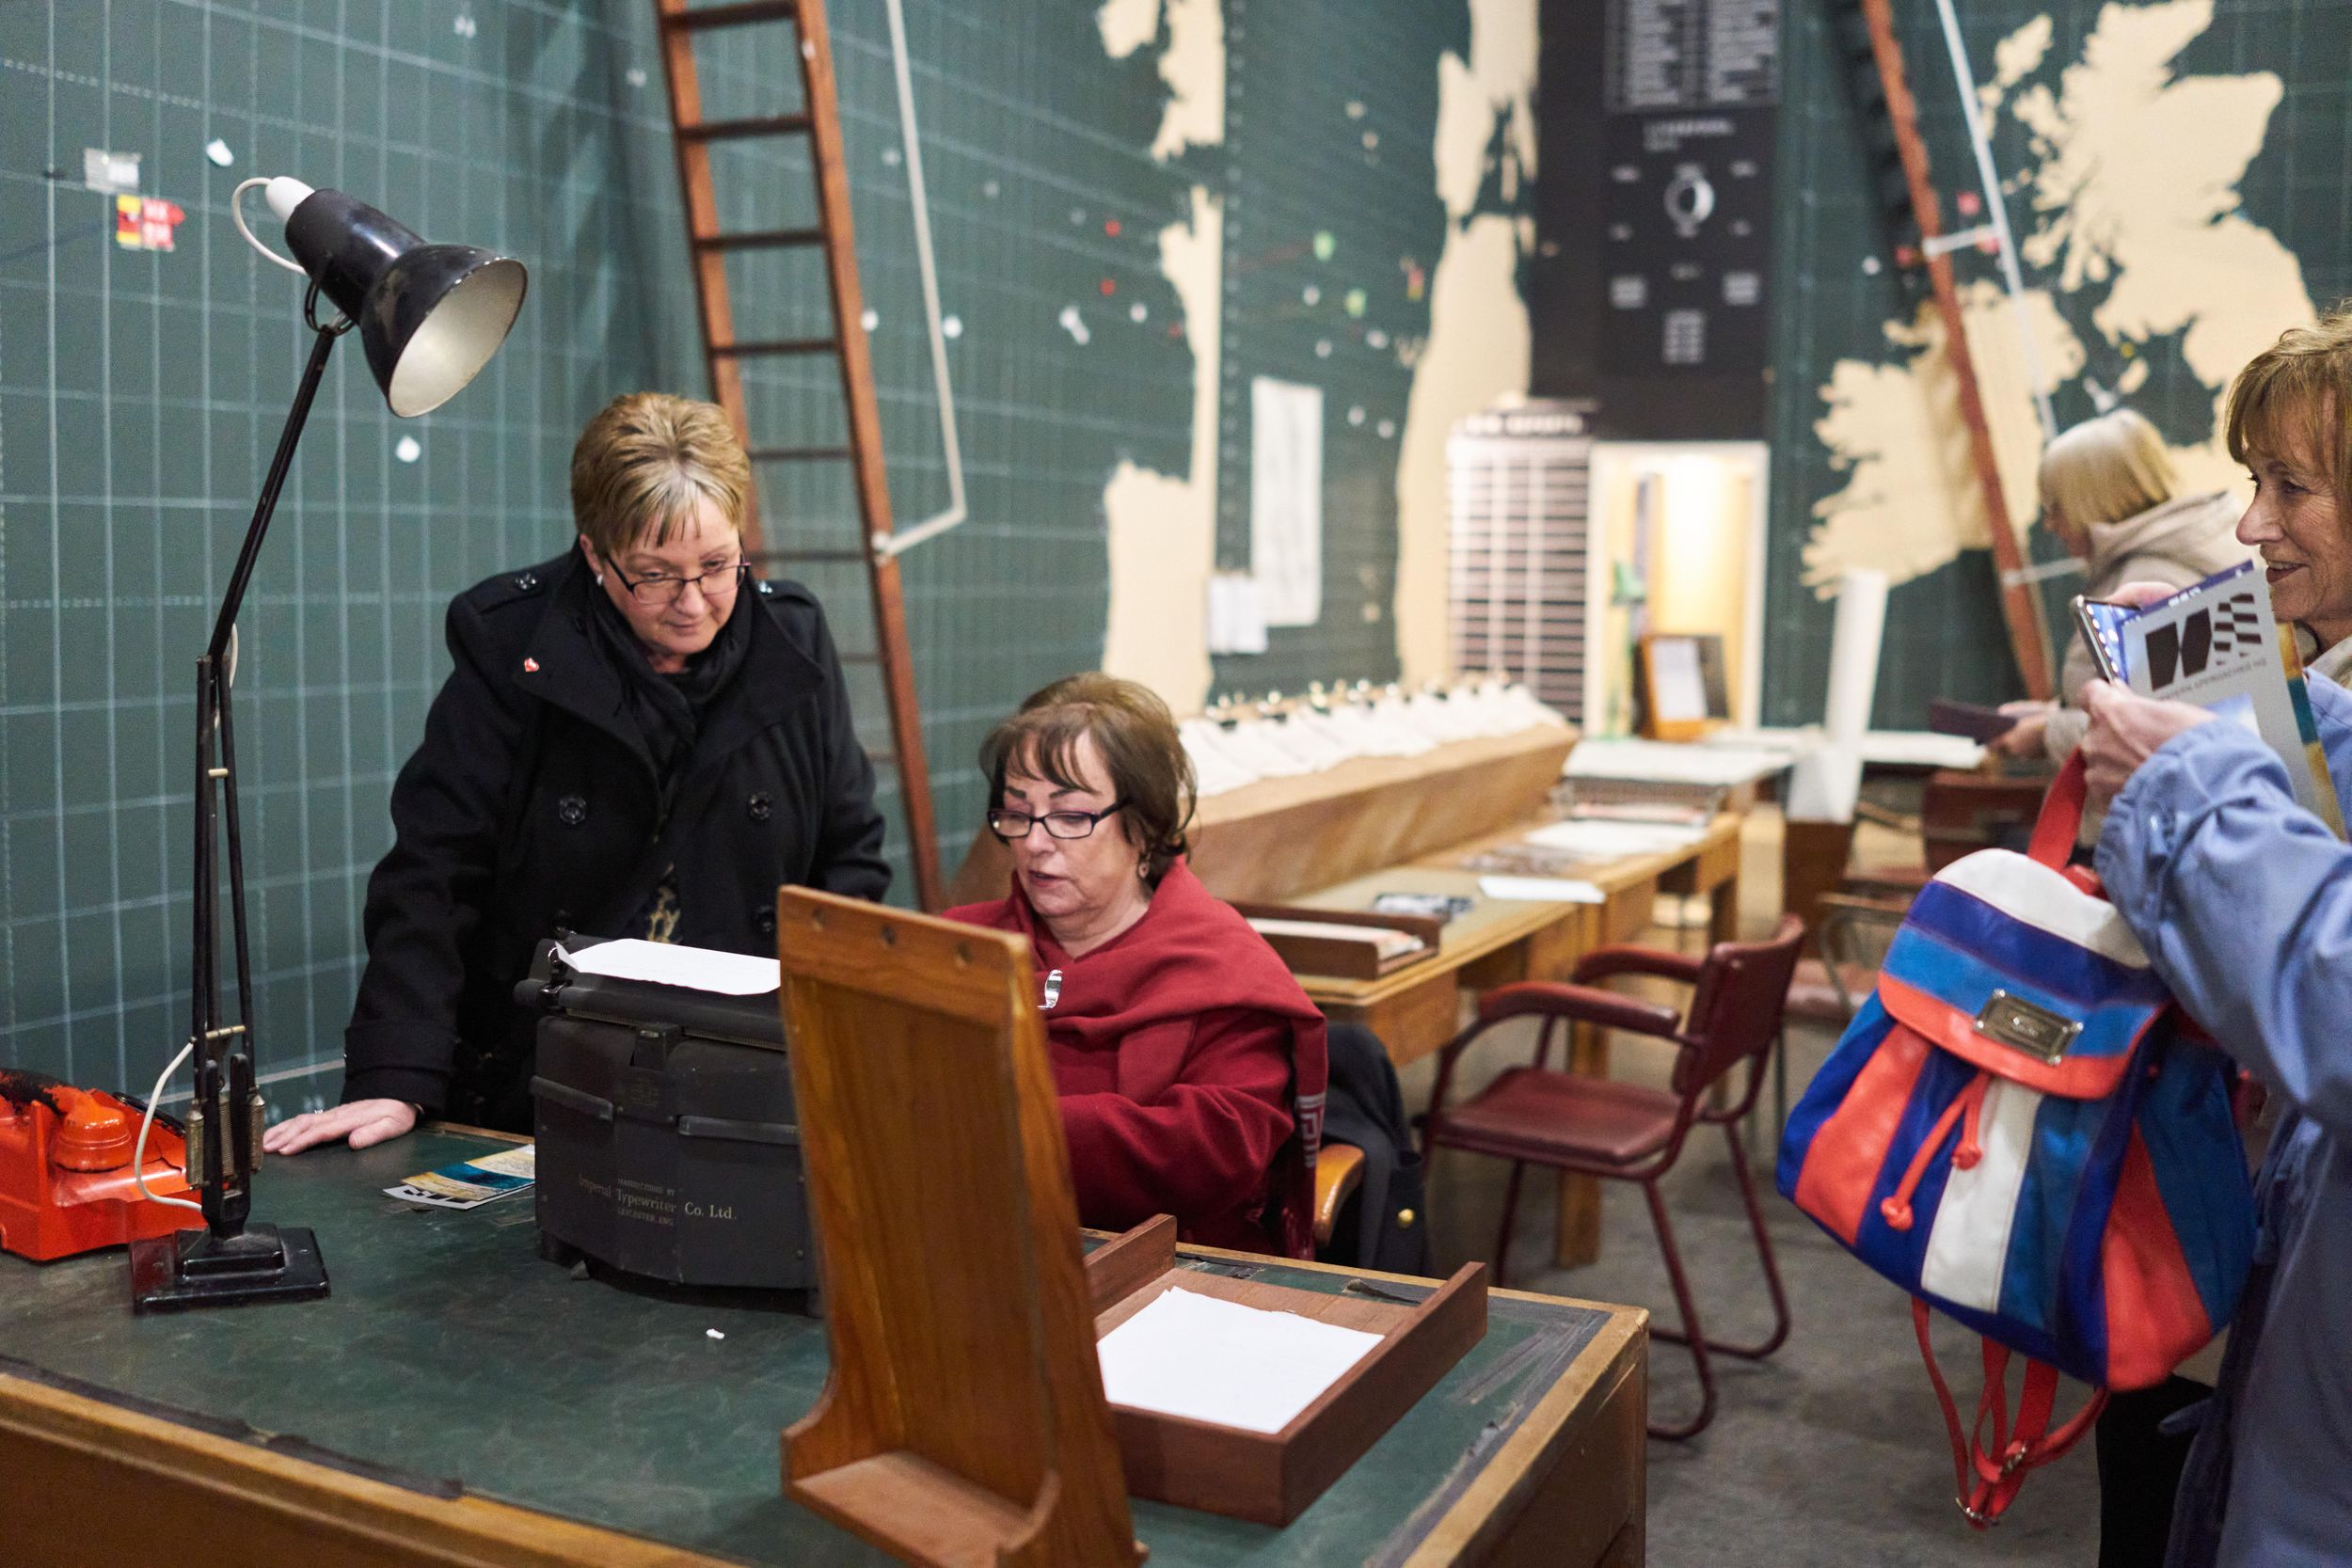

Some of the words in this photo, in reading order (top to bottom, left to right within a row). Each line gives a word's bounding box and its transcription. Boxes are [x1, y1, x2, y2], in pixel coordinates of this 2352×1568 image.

[616, 1188, 677, 1212] Typewriter
[684, 1201, 704, 1216] Co.
[709, 1204, 737, 1220] Ltd.
